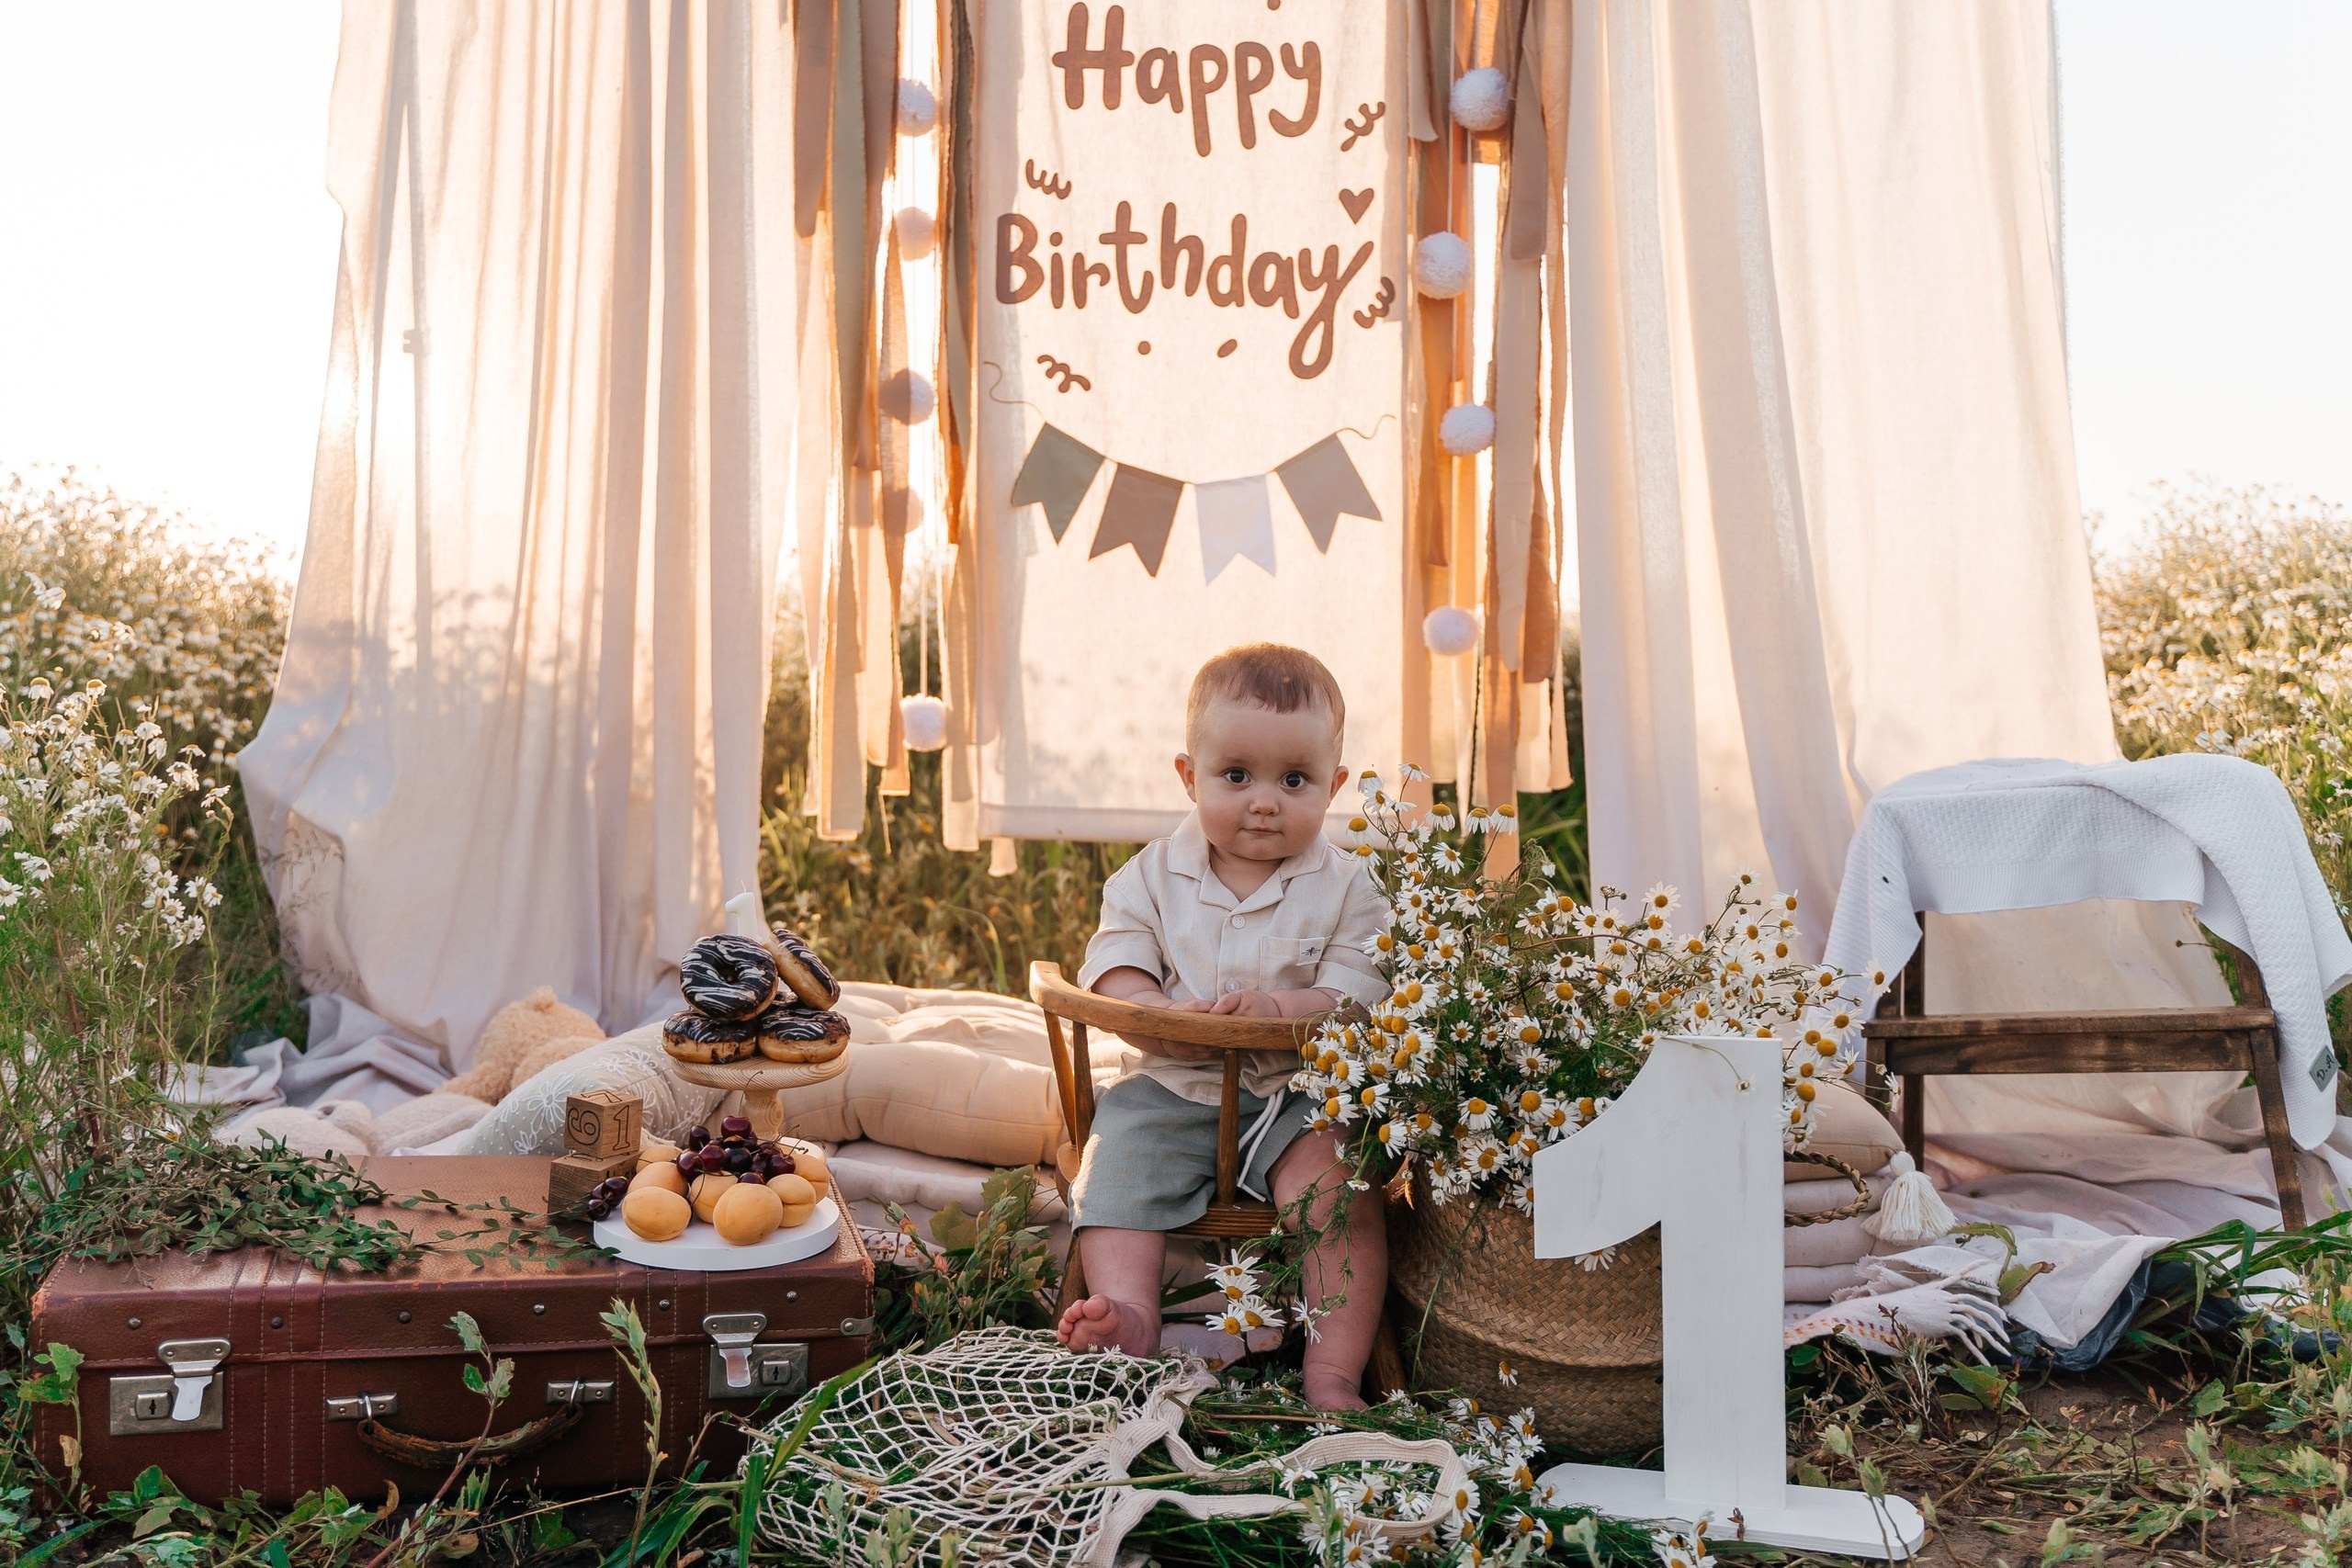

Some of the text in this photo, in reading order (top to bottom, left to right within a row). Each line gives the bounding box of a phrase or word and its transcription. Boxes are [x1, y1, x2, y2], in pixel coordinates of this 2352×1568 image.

[1051, 2, 1322, 157] Happy
[996, 200, 1374, 379] Birthday
[612, 1104, 631, 1151] 1
[1532, 1035, 1787, 1511] 1
